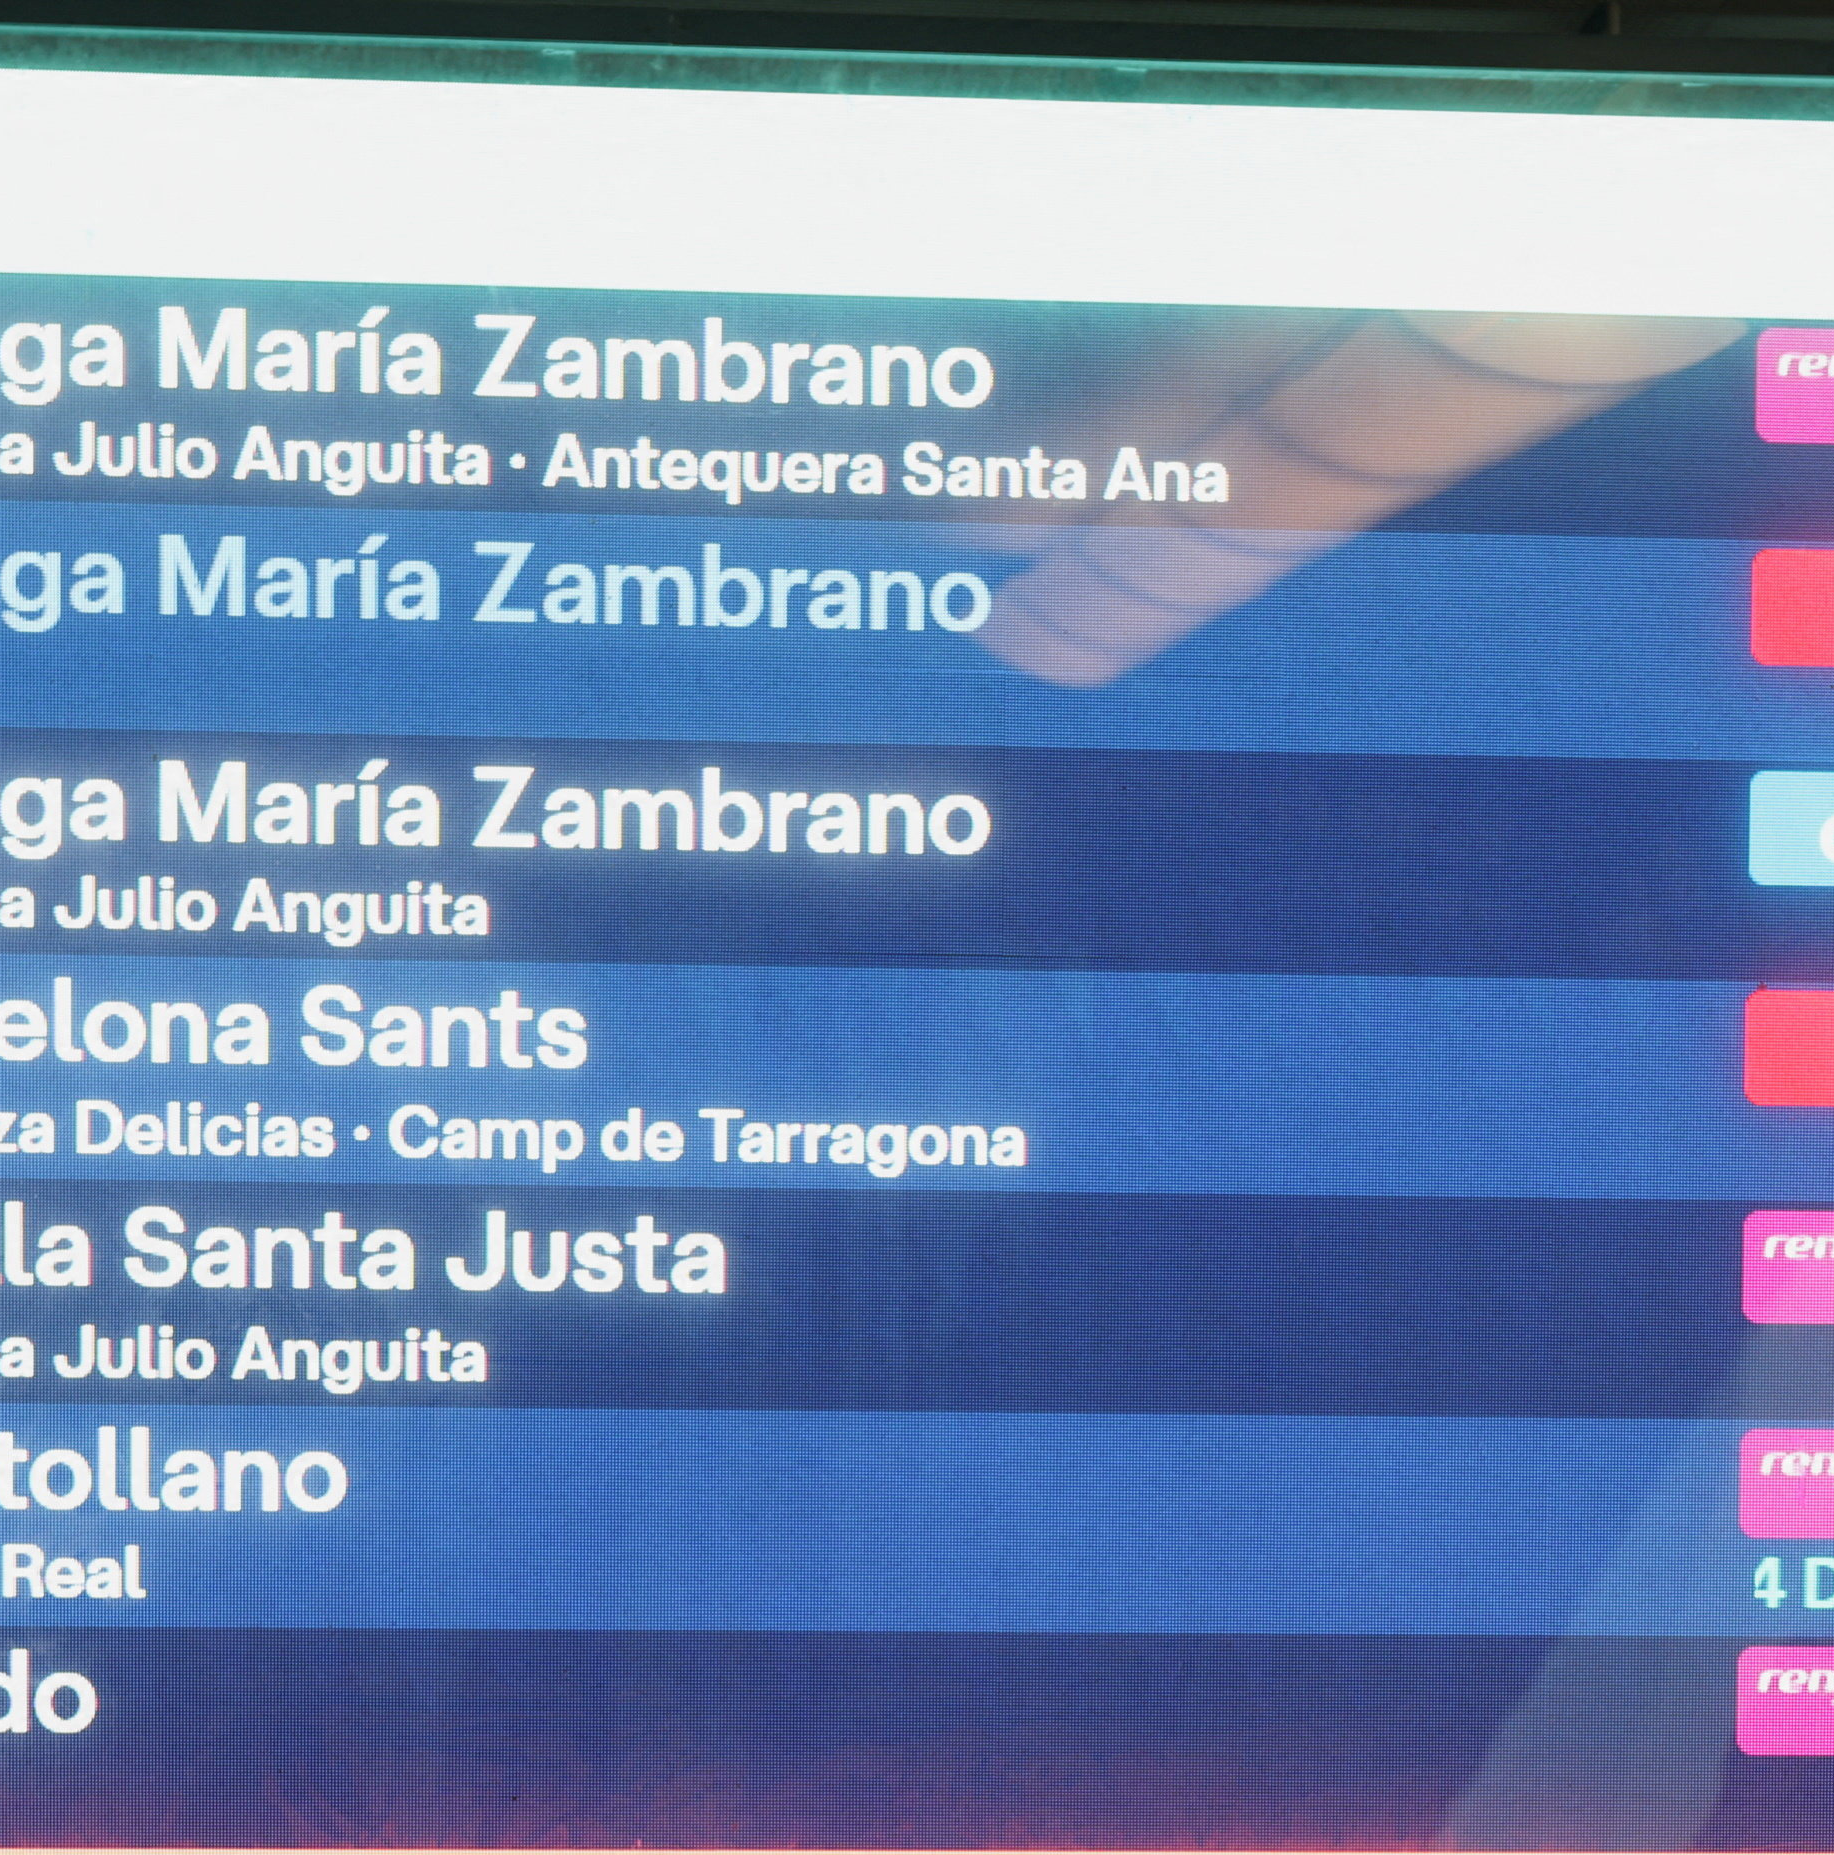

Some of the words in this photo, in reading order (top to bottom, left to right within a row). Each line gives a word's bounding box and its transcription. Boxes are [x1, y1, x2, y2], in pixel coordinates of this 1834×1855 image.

[159, 305, 442, 396] María
[474, 313, 995, 409] Zambrano
[53, 420, 218, 479] Julio
[233, 425, 490, 496] Anguita
[543, 432, 885, 505] Antequera
[902, 441, 1089, 501] Santa
[1103, 445, 1231, 504] Ana
[159, 535, 440, 620] María
[474, 542, 993, 632] Zambrano
[159, 759, 441, 847] María
[473, 765, 991, 856] Zambrano
[54, 874, 217, 932] Julio
[233, 877, 489, 948] Anguita
[301, 983, 588, 1070] Sants
[76, 1099, 335, 1158] Delicias
[388, 1104, 585, 1174] Camp
[600, 1107, 685, 1162] de
[699, 1108, 1026, 1178] Tarragona
[124, 1205, 415, 1291] Santa
[445, 1209, 725, 1294] Justa
[54, 1324, 216, 1380] Julio
[232, 1325, 487, 1395] Anguita
[2, 1543, 147, 1599] Real
